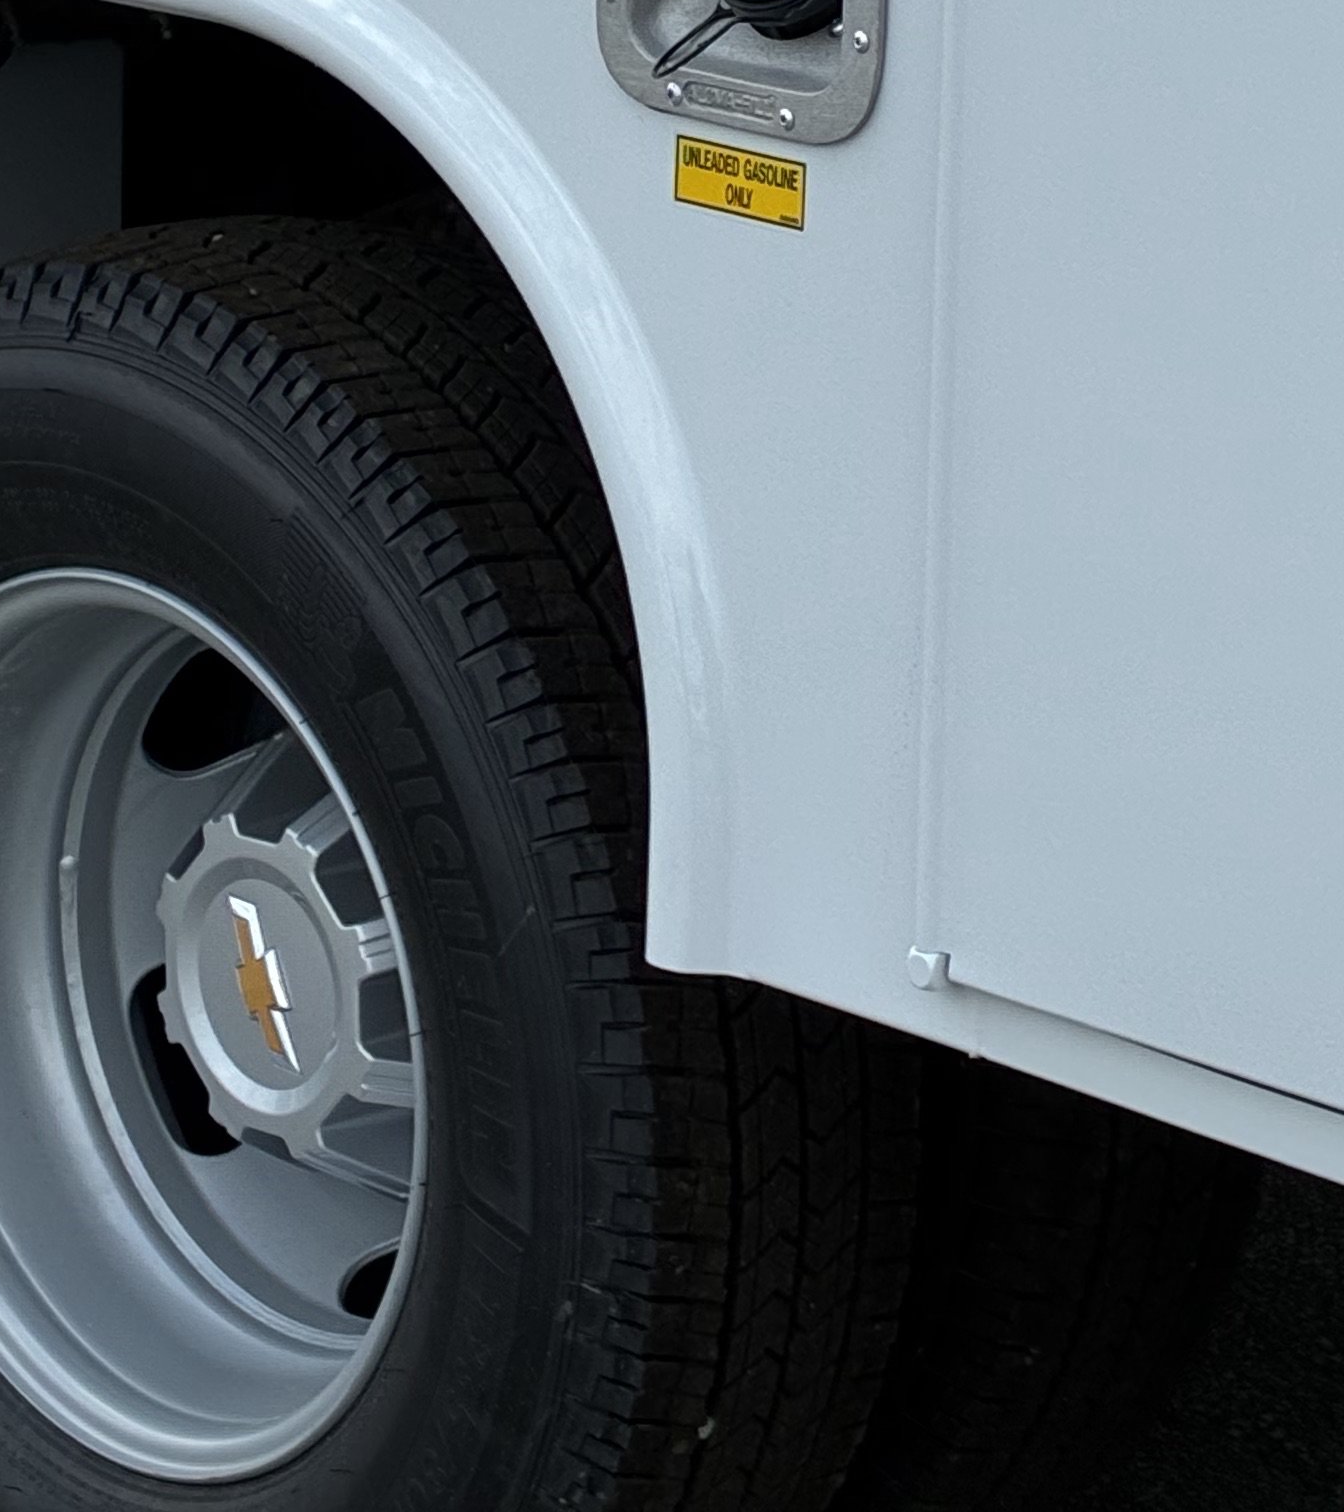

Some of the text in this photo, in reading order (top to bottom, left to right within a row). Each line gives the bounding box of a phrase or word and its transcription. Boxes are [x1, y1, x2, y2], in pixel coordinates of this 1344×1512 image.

[682, 144, 799, 192] UNLEADED GASOLINE
[724, 182, 754, 209] ONLY
